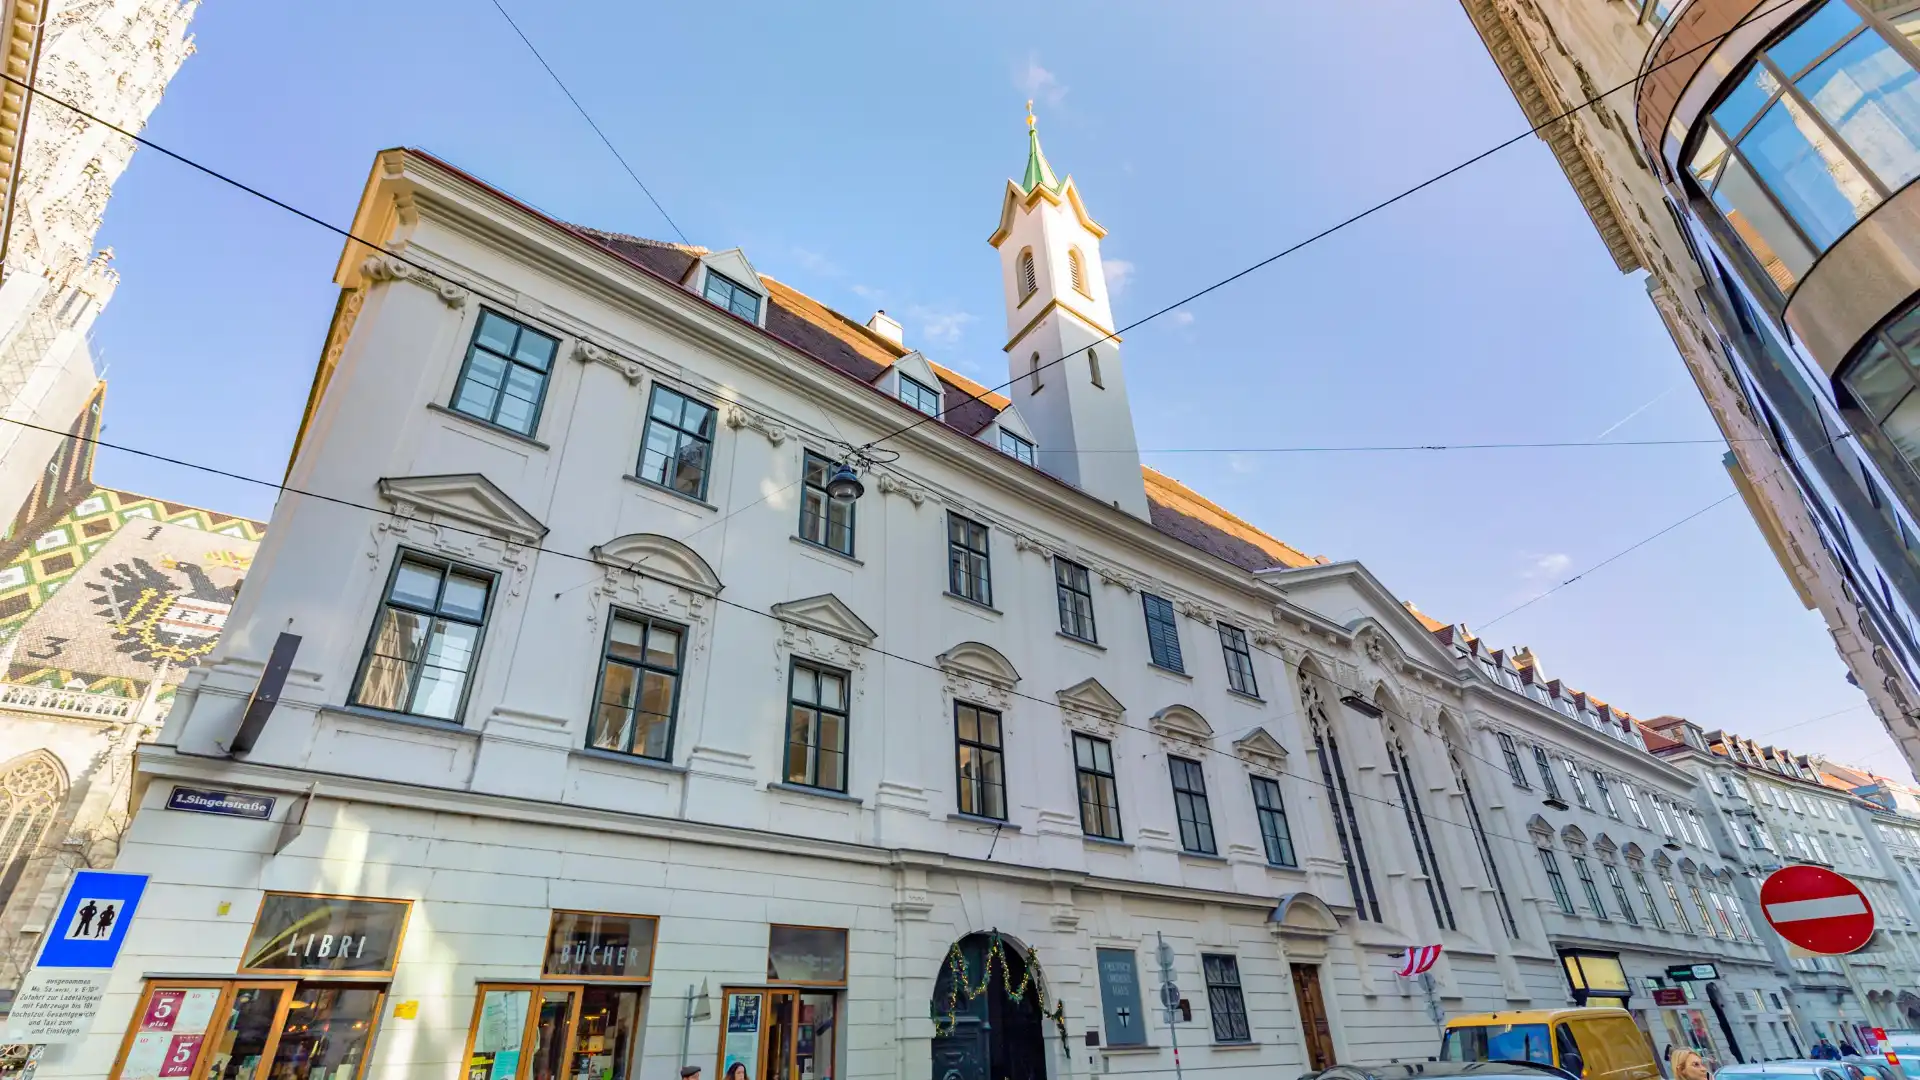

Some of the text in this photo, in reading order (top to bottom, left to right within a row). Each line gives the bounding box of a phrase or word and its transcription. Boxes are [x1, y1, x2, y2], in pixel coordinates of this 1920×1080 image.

[287, 933, 366, 958] LIBRI
[560, 940, 639, 967] BÜCHER
[153, 998, 175, 1018] 5
[172, 1042, 194, 1063] 5
